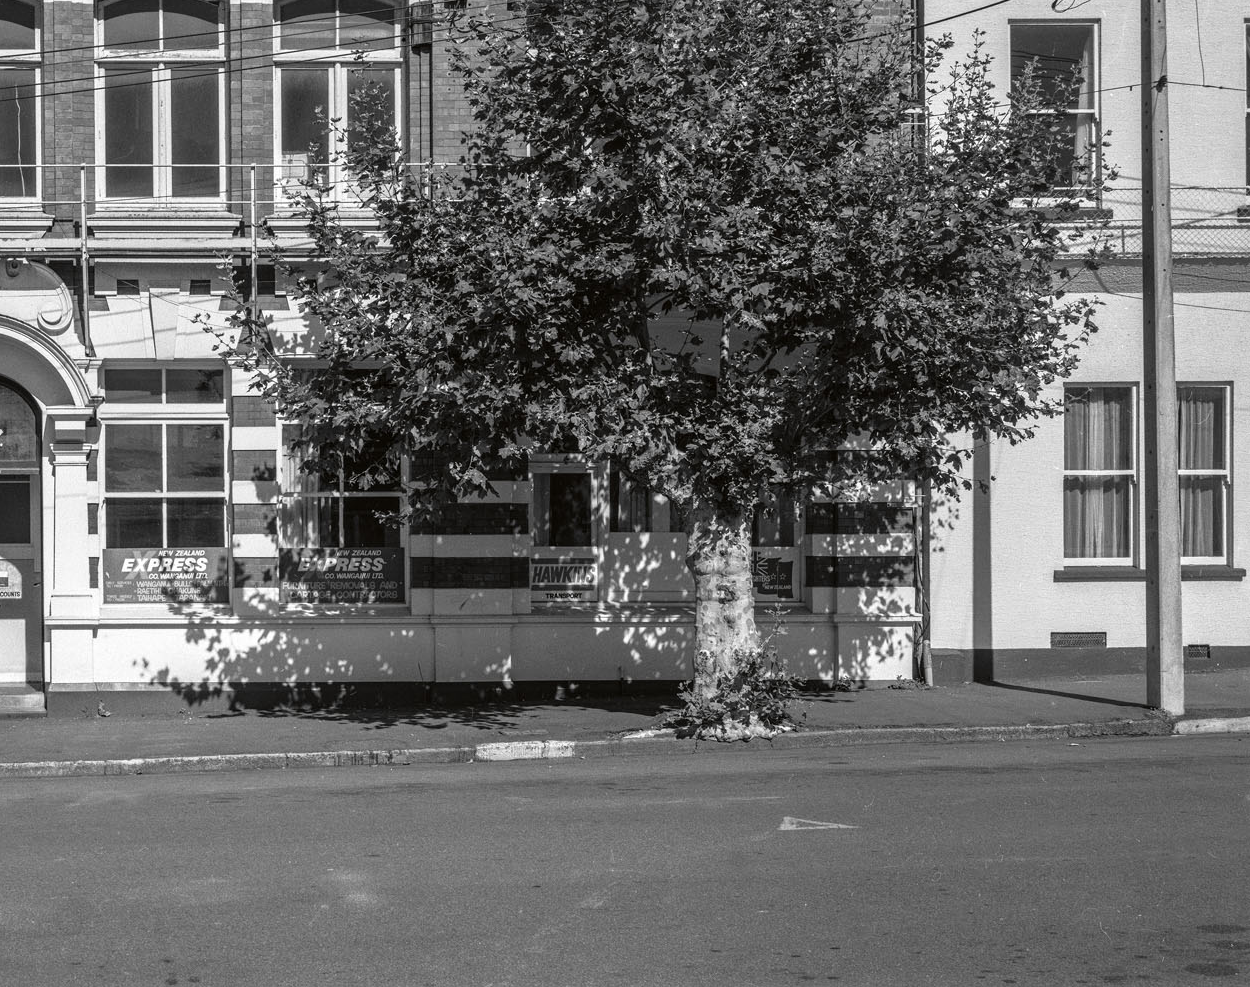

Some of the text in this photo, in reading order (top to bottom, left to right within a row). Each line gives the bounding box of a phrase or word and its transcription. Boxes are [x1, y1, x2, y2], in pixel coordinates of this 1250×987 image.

[121, 557, 209, 573] EXPRESS
[297, 557, 385, 572] EXPRESS
[532, 565, 595, 584] HAWKINS
[282, 581, 398, 590] FURNITURE REMOVALS AND
[137, 594, 166, 602] TAIHAPE
